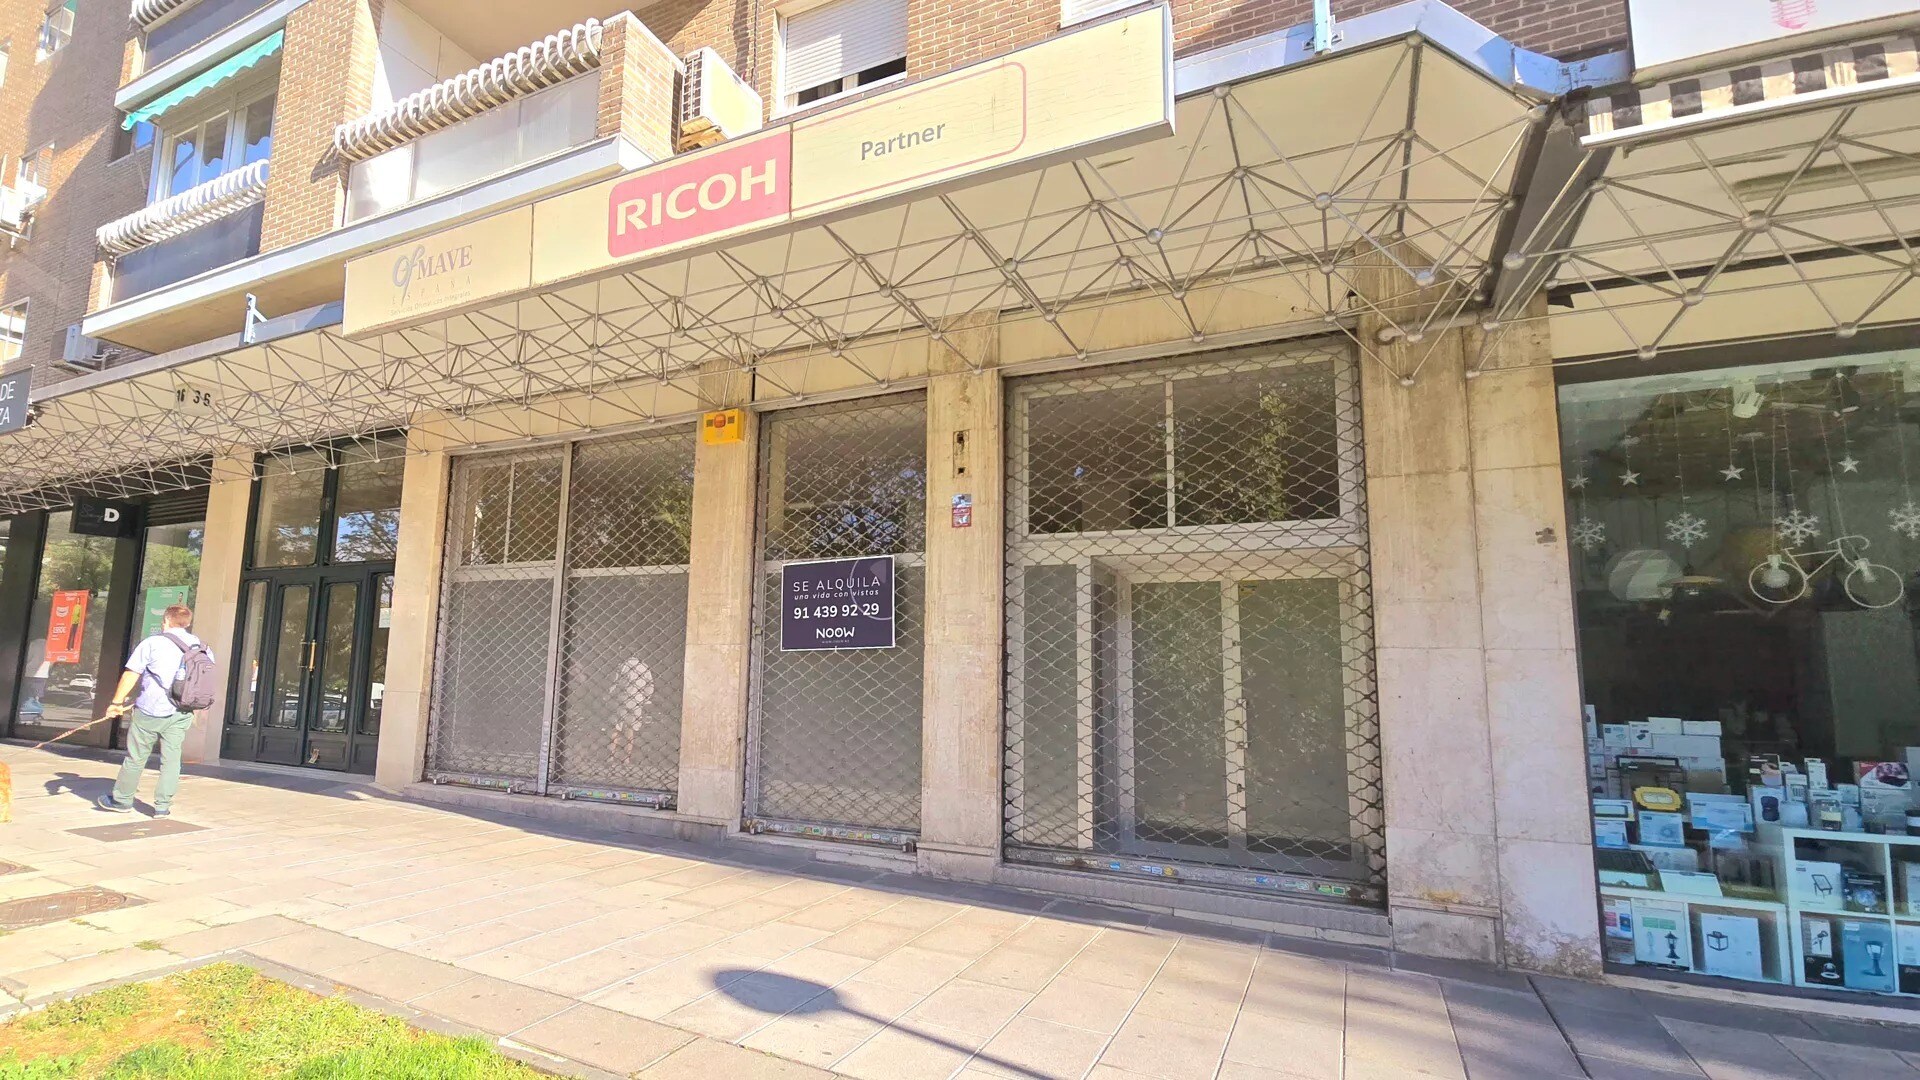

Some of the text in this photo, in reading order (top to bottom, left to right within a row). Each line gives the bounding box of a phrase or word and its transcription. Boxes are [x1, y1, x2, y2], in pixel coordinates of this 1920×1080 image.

[861, 123, 946, 161] Partner
[616, 158, 777, 236] RICOH
[104, 507, 120, 523] D
[793, 576, 880, 592] SE ALQUILA
[812, 591, 830, 599] vida
[833, 590, 849, 598] con
[852, 589, 879, 597] vistas
[793, 602, 880, 620] 91 439 92 29
[816, 626, 855, 639] NOOW
